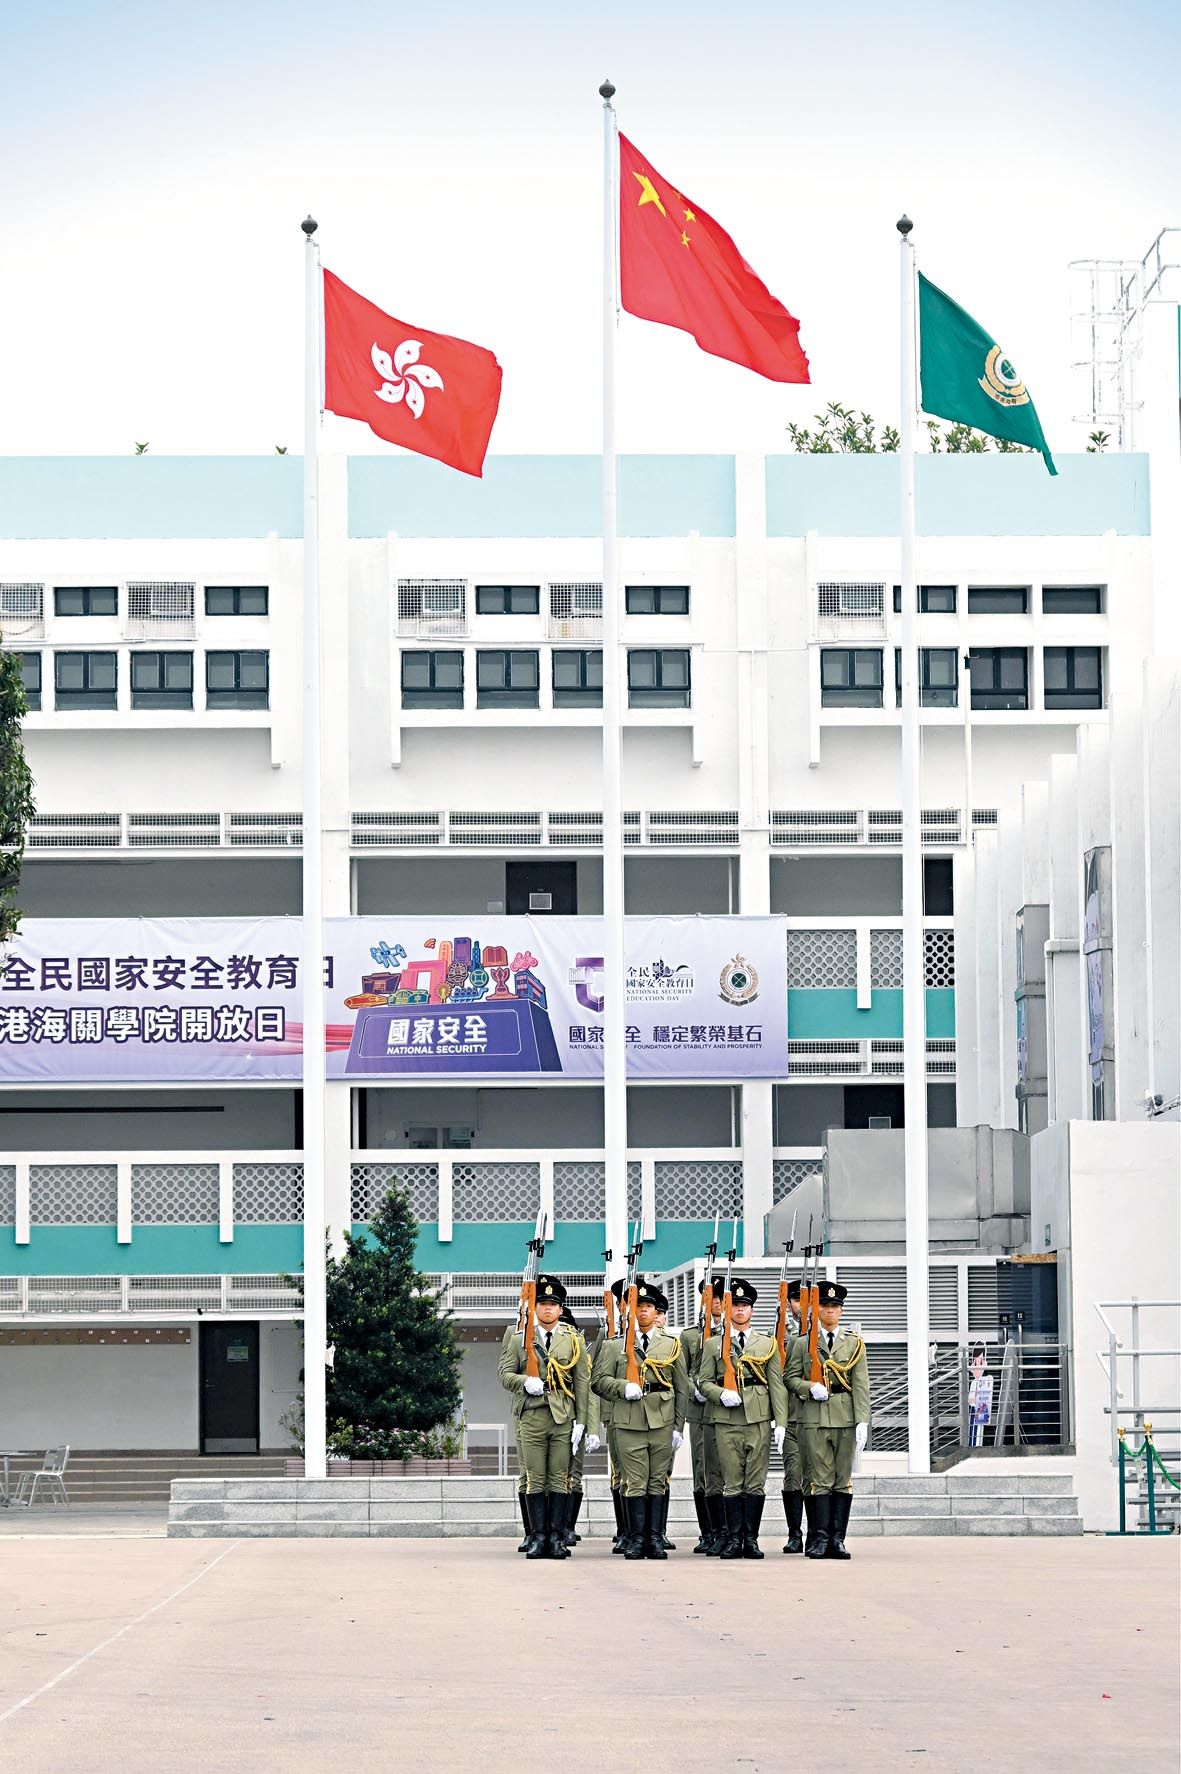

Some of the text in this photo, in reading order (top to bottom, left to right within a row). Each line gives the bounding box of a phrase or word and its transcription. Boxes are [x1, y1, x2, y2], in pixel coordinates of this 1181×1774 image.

[627, 966, 650, 977] 全民
[0, 1005, 286, 1044] 港海關學院開放日
[387, 1015, 488, 1045] 國家安全
[569, 1025, 763, 1043] 國家全 穩定繁榮基石
[387, 1044, 487, 1055] NATIONAL SECURITY
